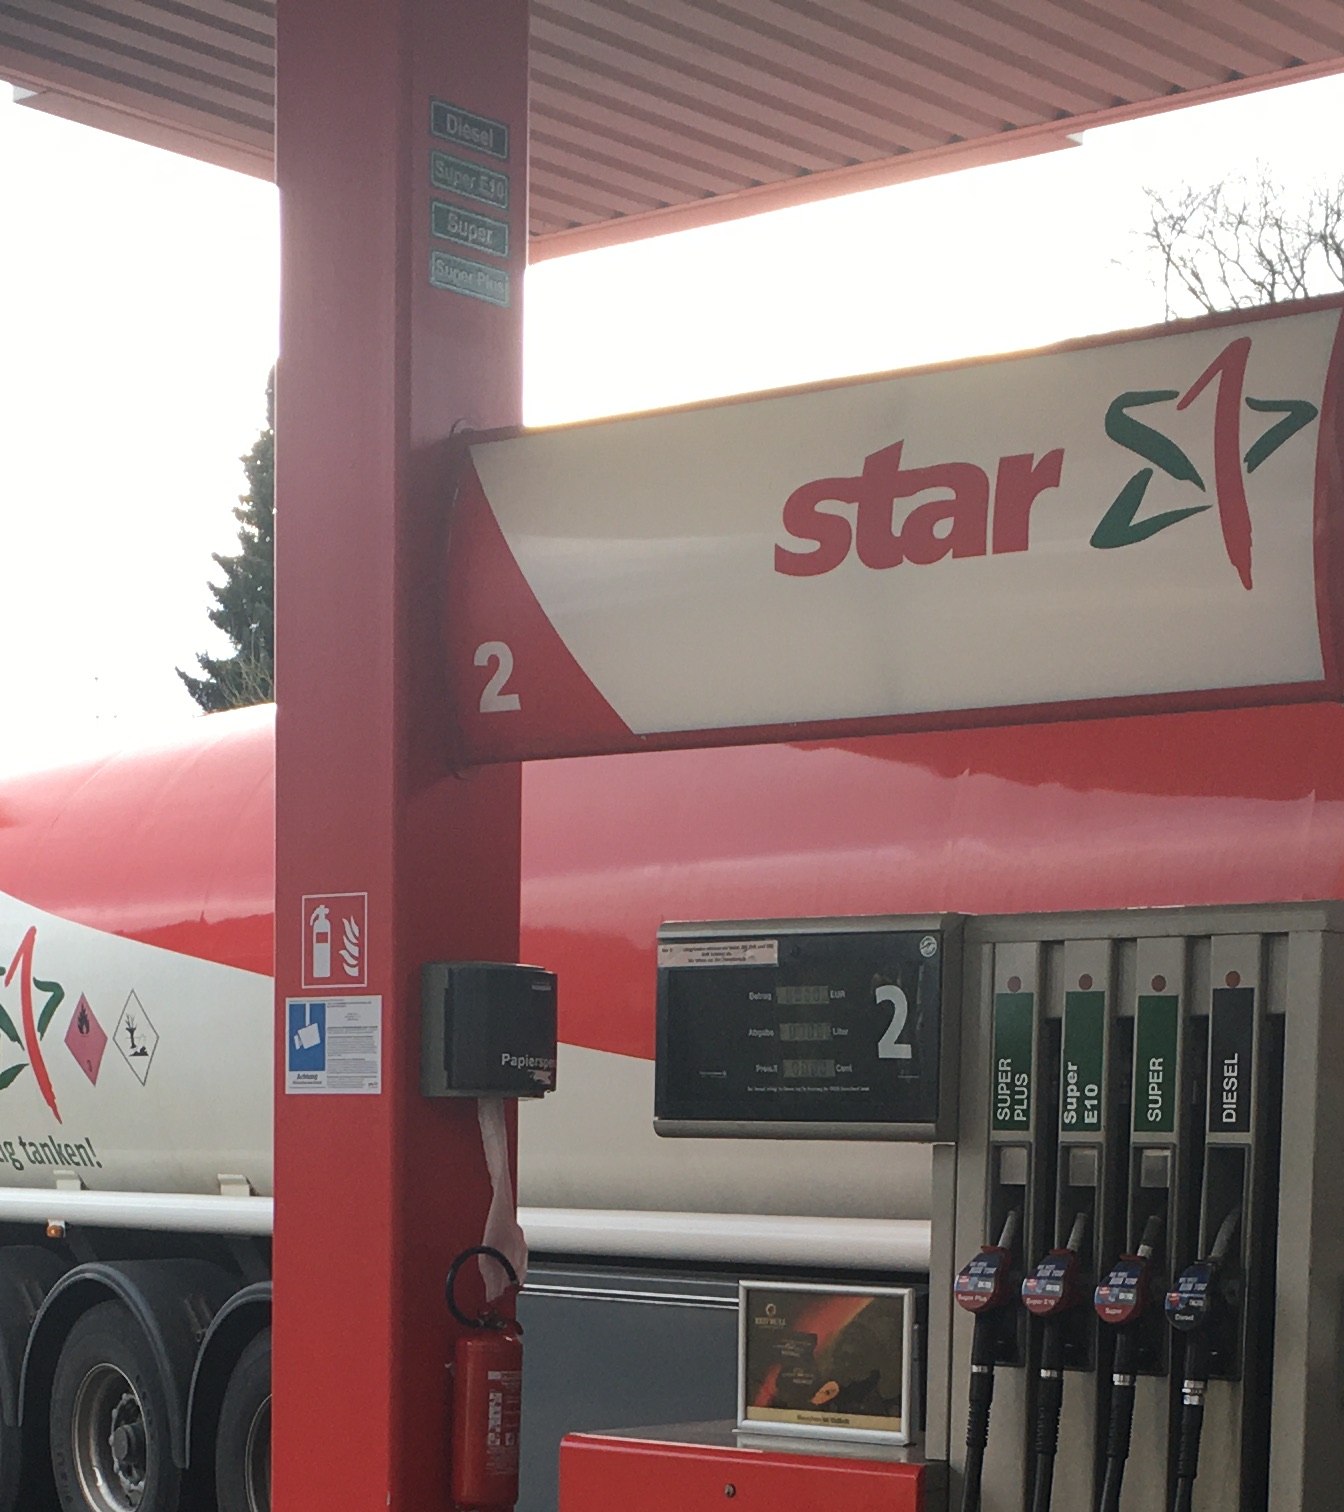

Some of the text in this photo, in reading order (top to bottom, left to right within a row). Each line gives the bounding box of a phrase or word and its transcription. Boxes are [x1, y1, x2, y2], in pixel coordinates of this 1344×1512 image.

[446, 113, 494, 148] Diesel
[434, 160, 476, 191] Super
[447, 212, 493, 246] Super
[435, 258, 504, 293] Super Plus
[773, 438, 1065, 578] star
[472, 640, 521, 714] 2
[830, 990, 846, 999] EUR
[874, 984, 913, 1060] 2
[997, 1058, 1012, 1121] SUPER
[1014, 1073, 1028, 1122] PLUS
[1063, 1062, 1080, 1125] Super
[1084, 1083, 1099, 1124] E10
[1147, 1057, 1164, 1122] SUPER
[1222, 1052, 1239, 1123] DIESEL
[18, 1134, 103, 1170] tanken!
